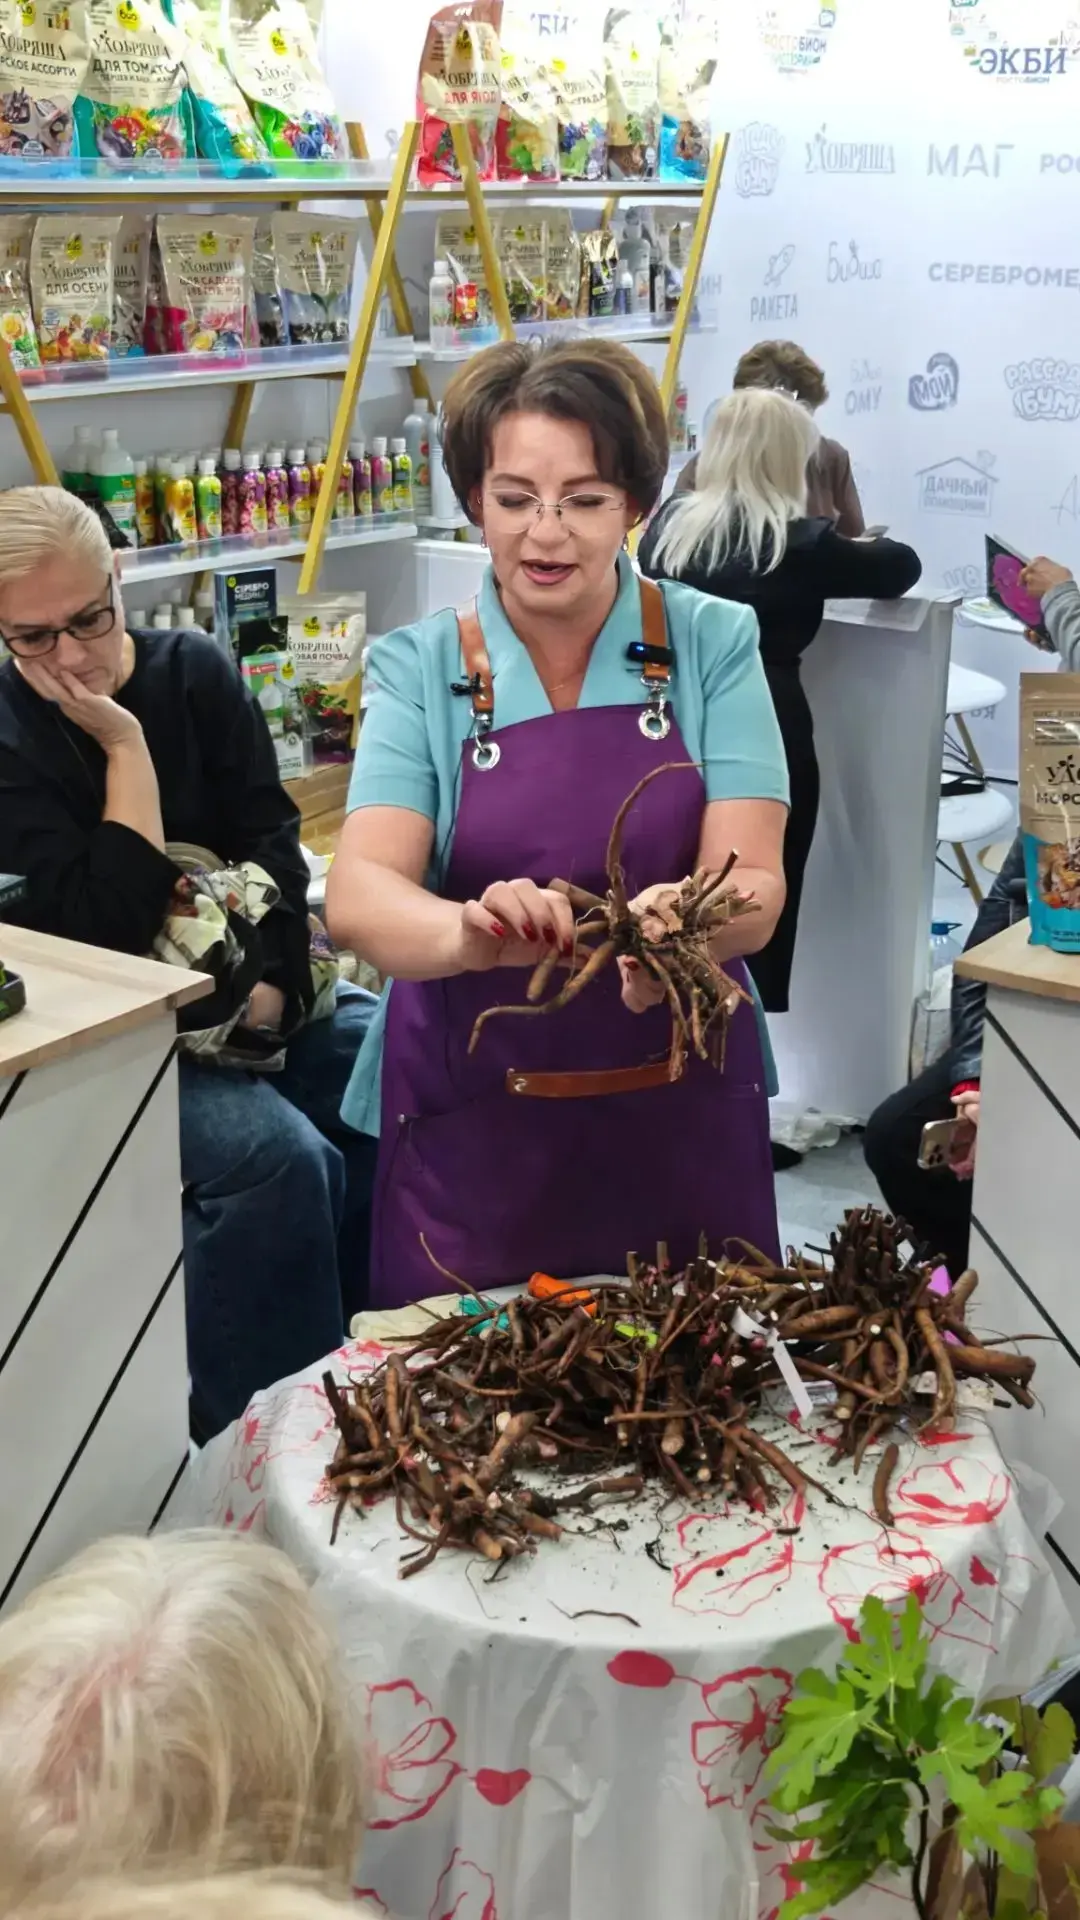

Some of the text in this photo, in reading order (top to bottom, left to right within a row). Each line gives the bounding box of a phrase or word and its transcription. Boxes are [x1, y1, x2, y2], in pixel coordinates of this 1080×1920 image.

[31, 62, 77, 77] АССОРТИ
[93, 59, 121, 74] ДЛЯ
[979, 47, 1068, 75] ЭКБИ
[927, 143, 1015, 179] МАГ
[928, 262, 1080, 290] СЕРЕБРОМЕ
[46, 282, 69, 296] ДЛЯ
[750, 293, 798, 322] РАКЕТА
[924, 474, 989, 497] ДАЧНЫЙ
